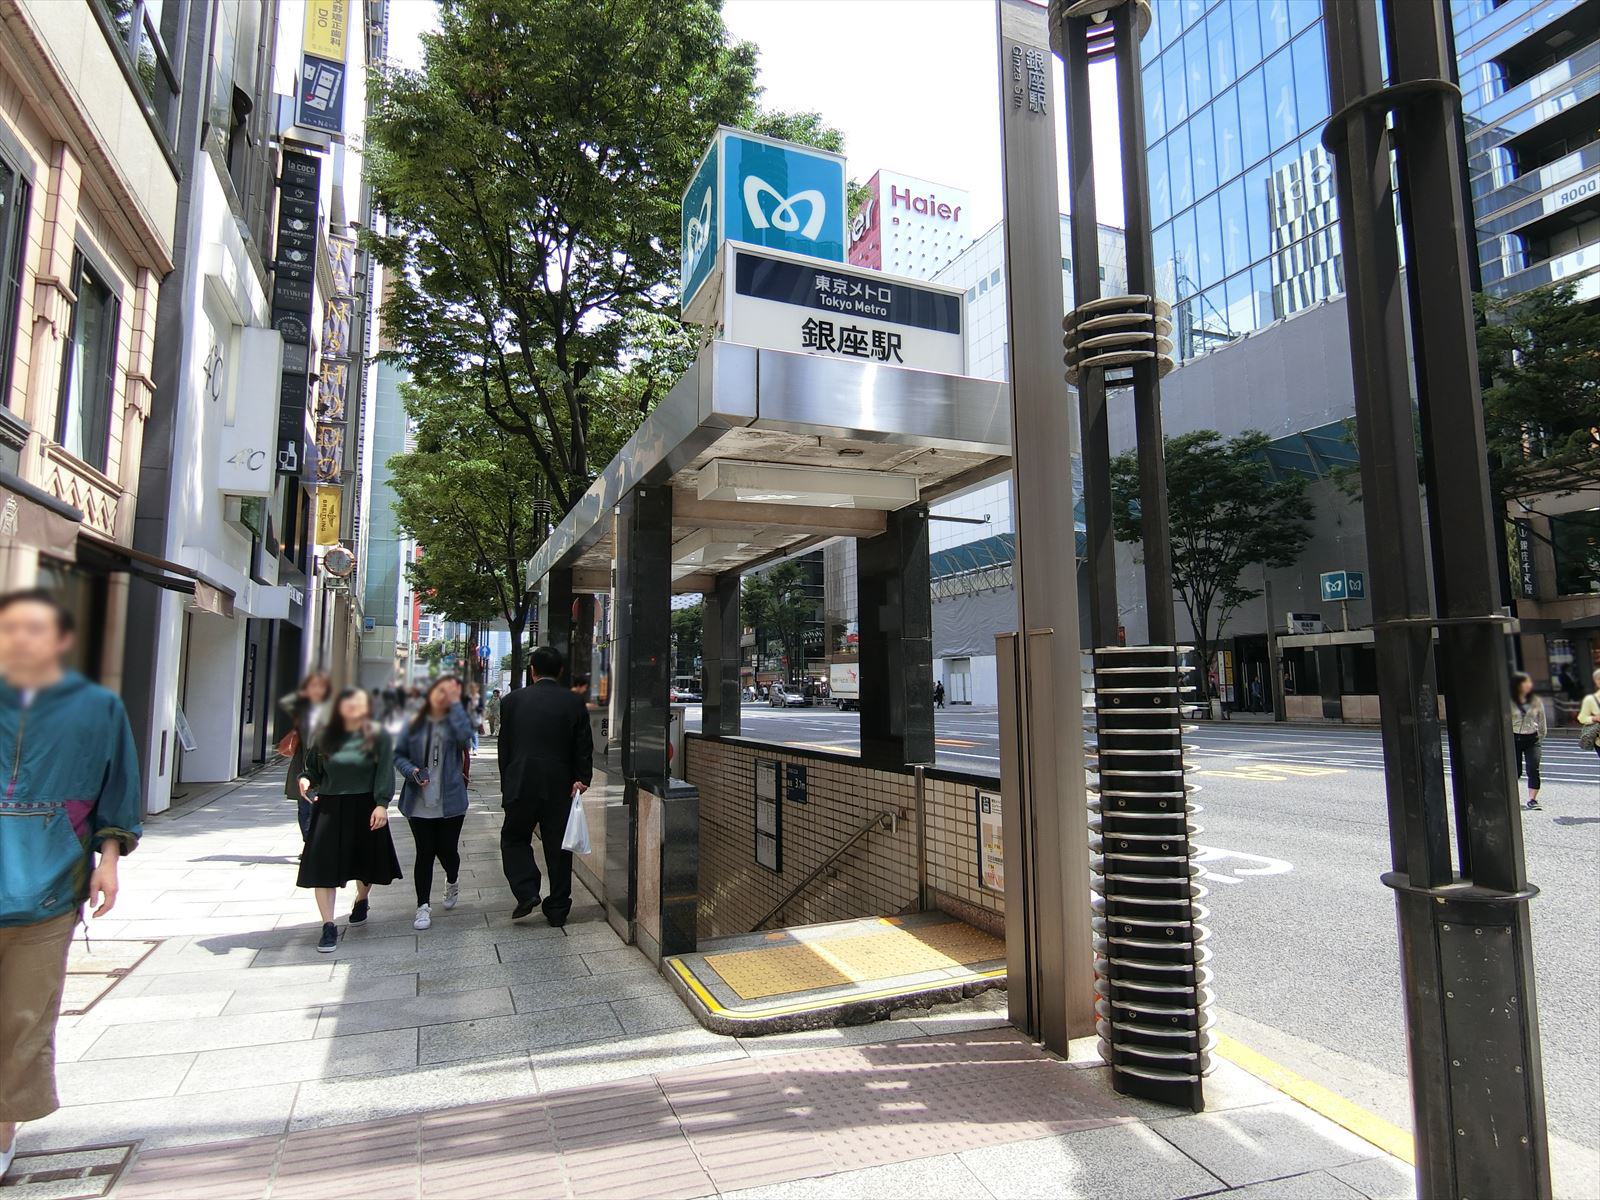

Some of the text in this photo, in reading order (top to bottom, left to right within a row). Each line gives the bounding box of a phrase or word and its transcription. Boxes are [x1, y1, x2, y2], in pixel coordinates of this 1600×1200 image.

[1026, 48, 1047, 116] 銀座駅
[891, 184, 962, 222] Haier
[815, 274, 892, 304] 東京メトロ
[819, 293, 887, 317] Tokyo Metro
[801, 317, 904, 364] 銀座駅
